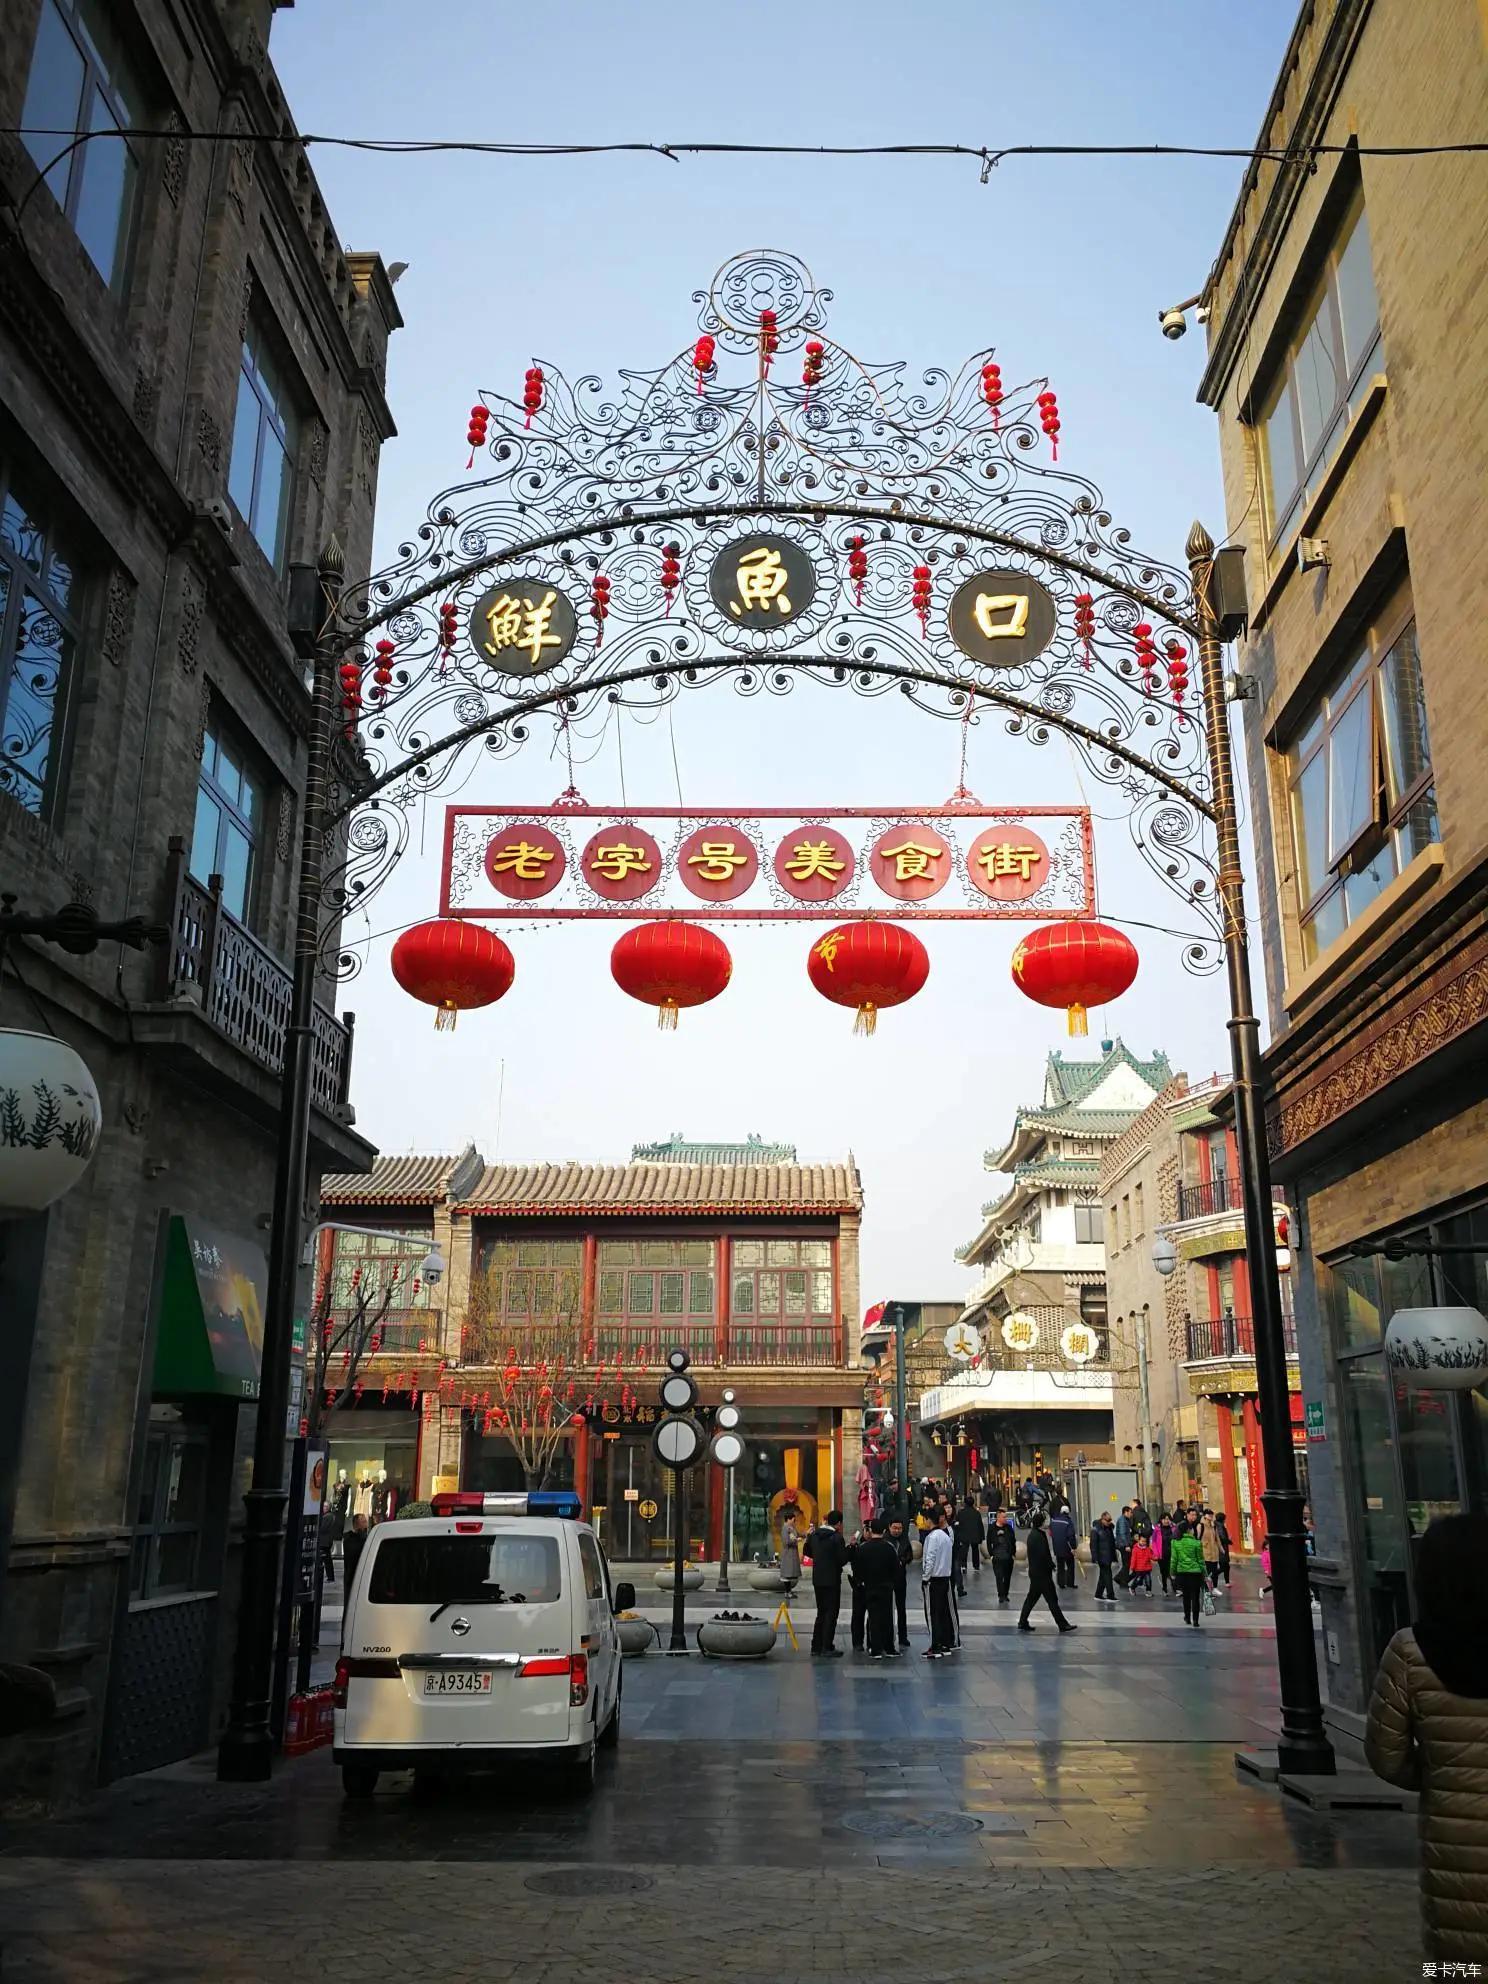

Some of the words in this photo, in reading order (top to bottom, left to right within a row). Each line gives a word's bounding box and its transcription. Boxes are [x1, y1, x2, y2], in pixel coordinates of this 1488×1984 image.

[494, 841, 1041, 881] 老字号美食街
